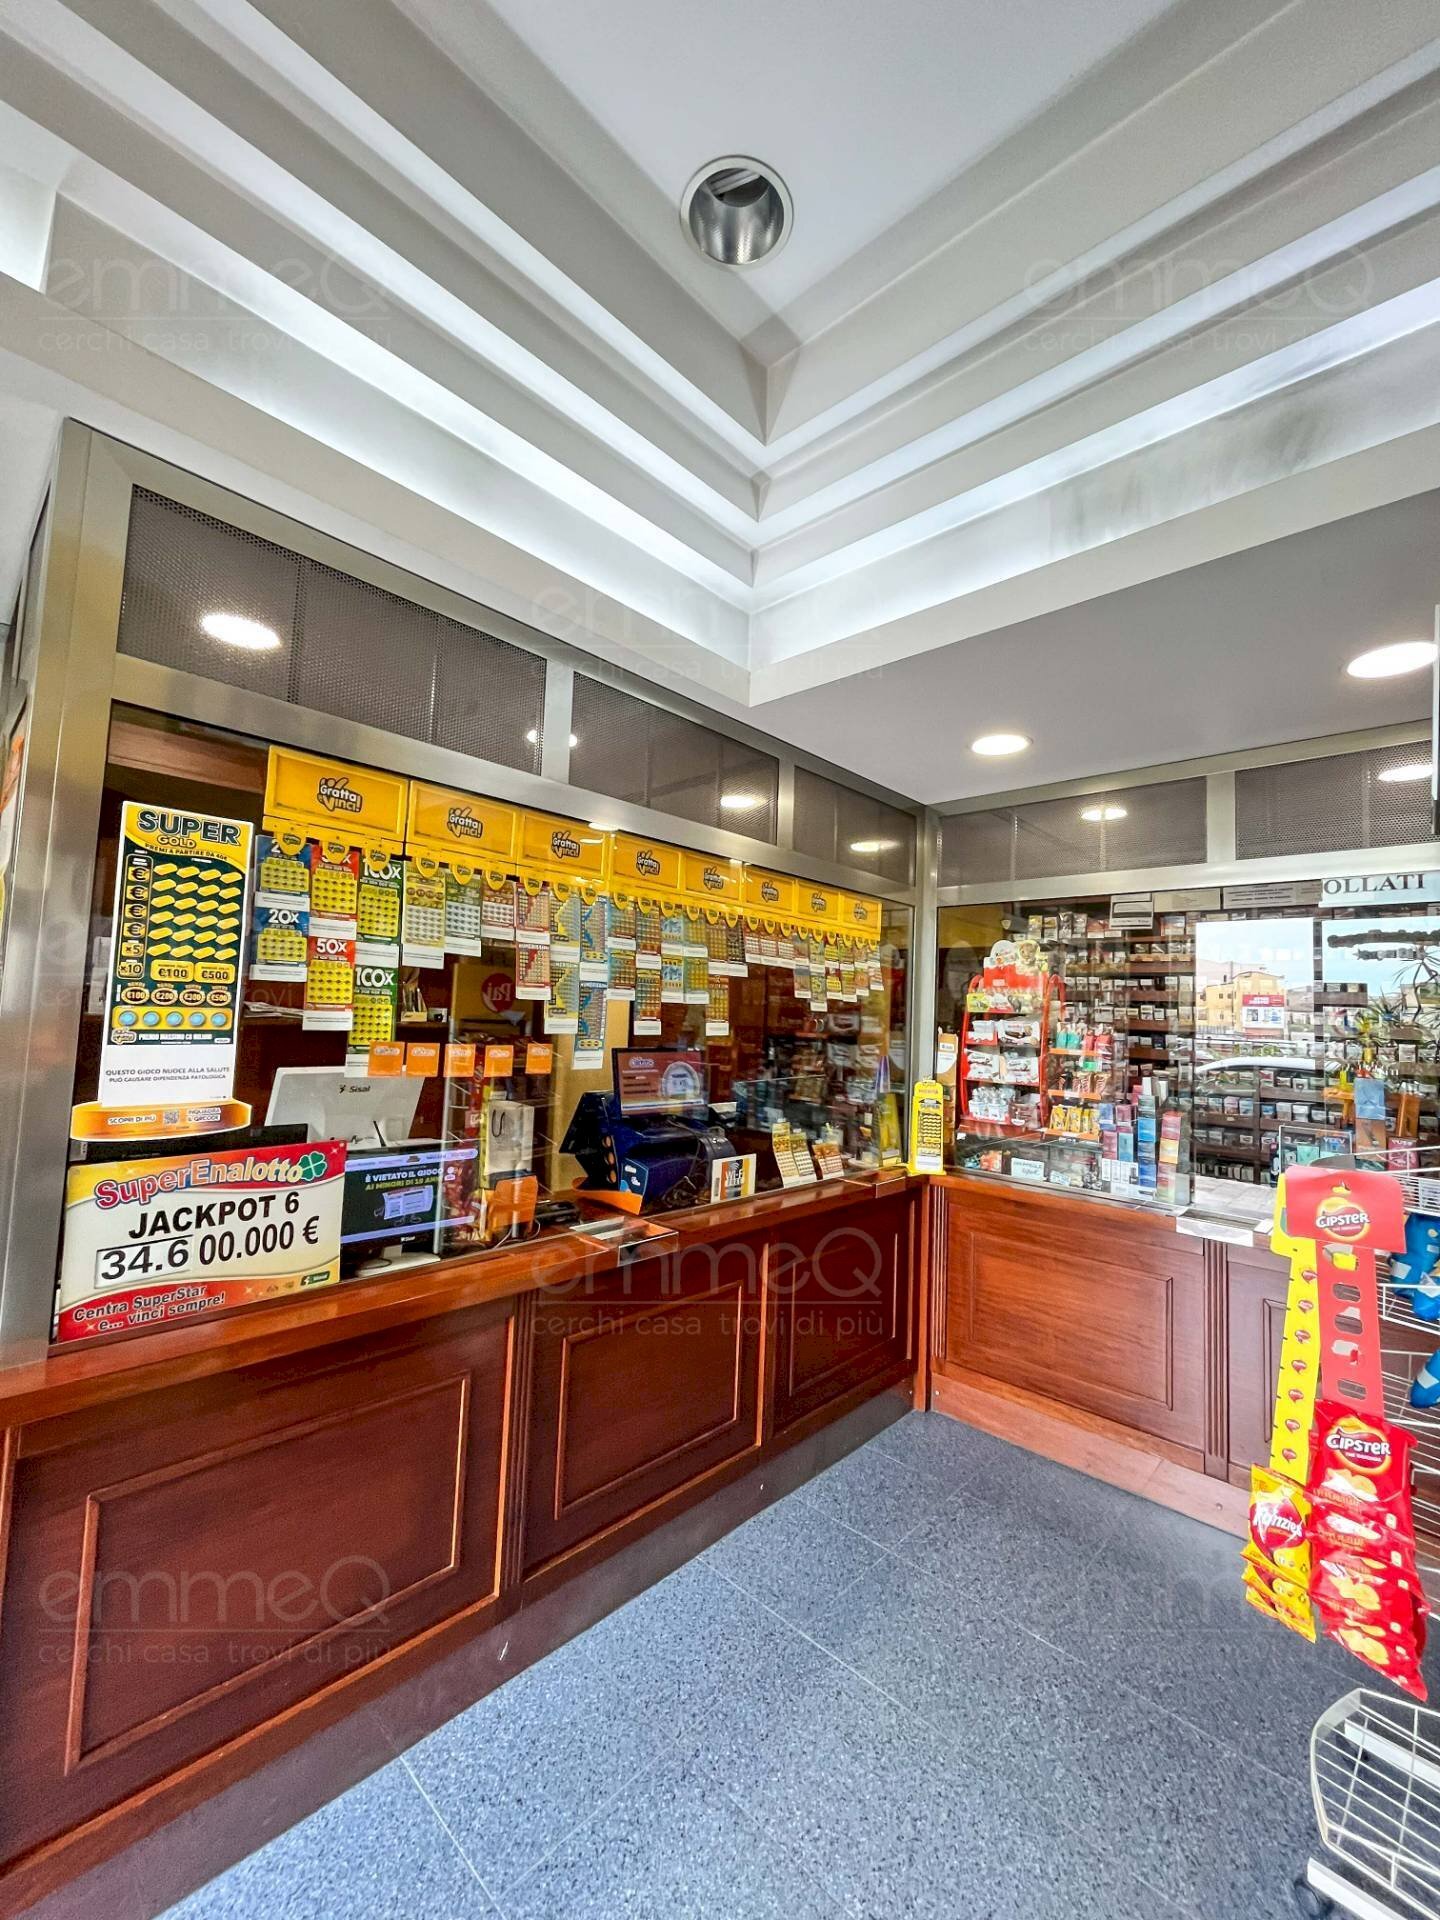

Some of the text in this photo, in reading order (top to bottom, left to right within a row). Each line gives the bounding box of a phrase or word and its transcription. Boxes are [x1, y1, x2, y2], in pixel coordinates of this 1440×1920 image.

[138, 810, 241, 846] SUPER
[157, 835, 197, 849] GOLD
[95, 1156, 302, 1210] SuperEnalotto
[128, 1191, 300, 1239] JACKPOT 6
[100, 1216, 320, 1280] 34.6 00.000 €
[73, 1284, 206, 1322] Centra SuperStar
[128, 1308, 164, 1325] vinci
[168, 1293, 226, 1316] sempre!
